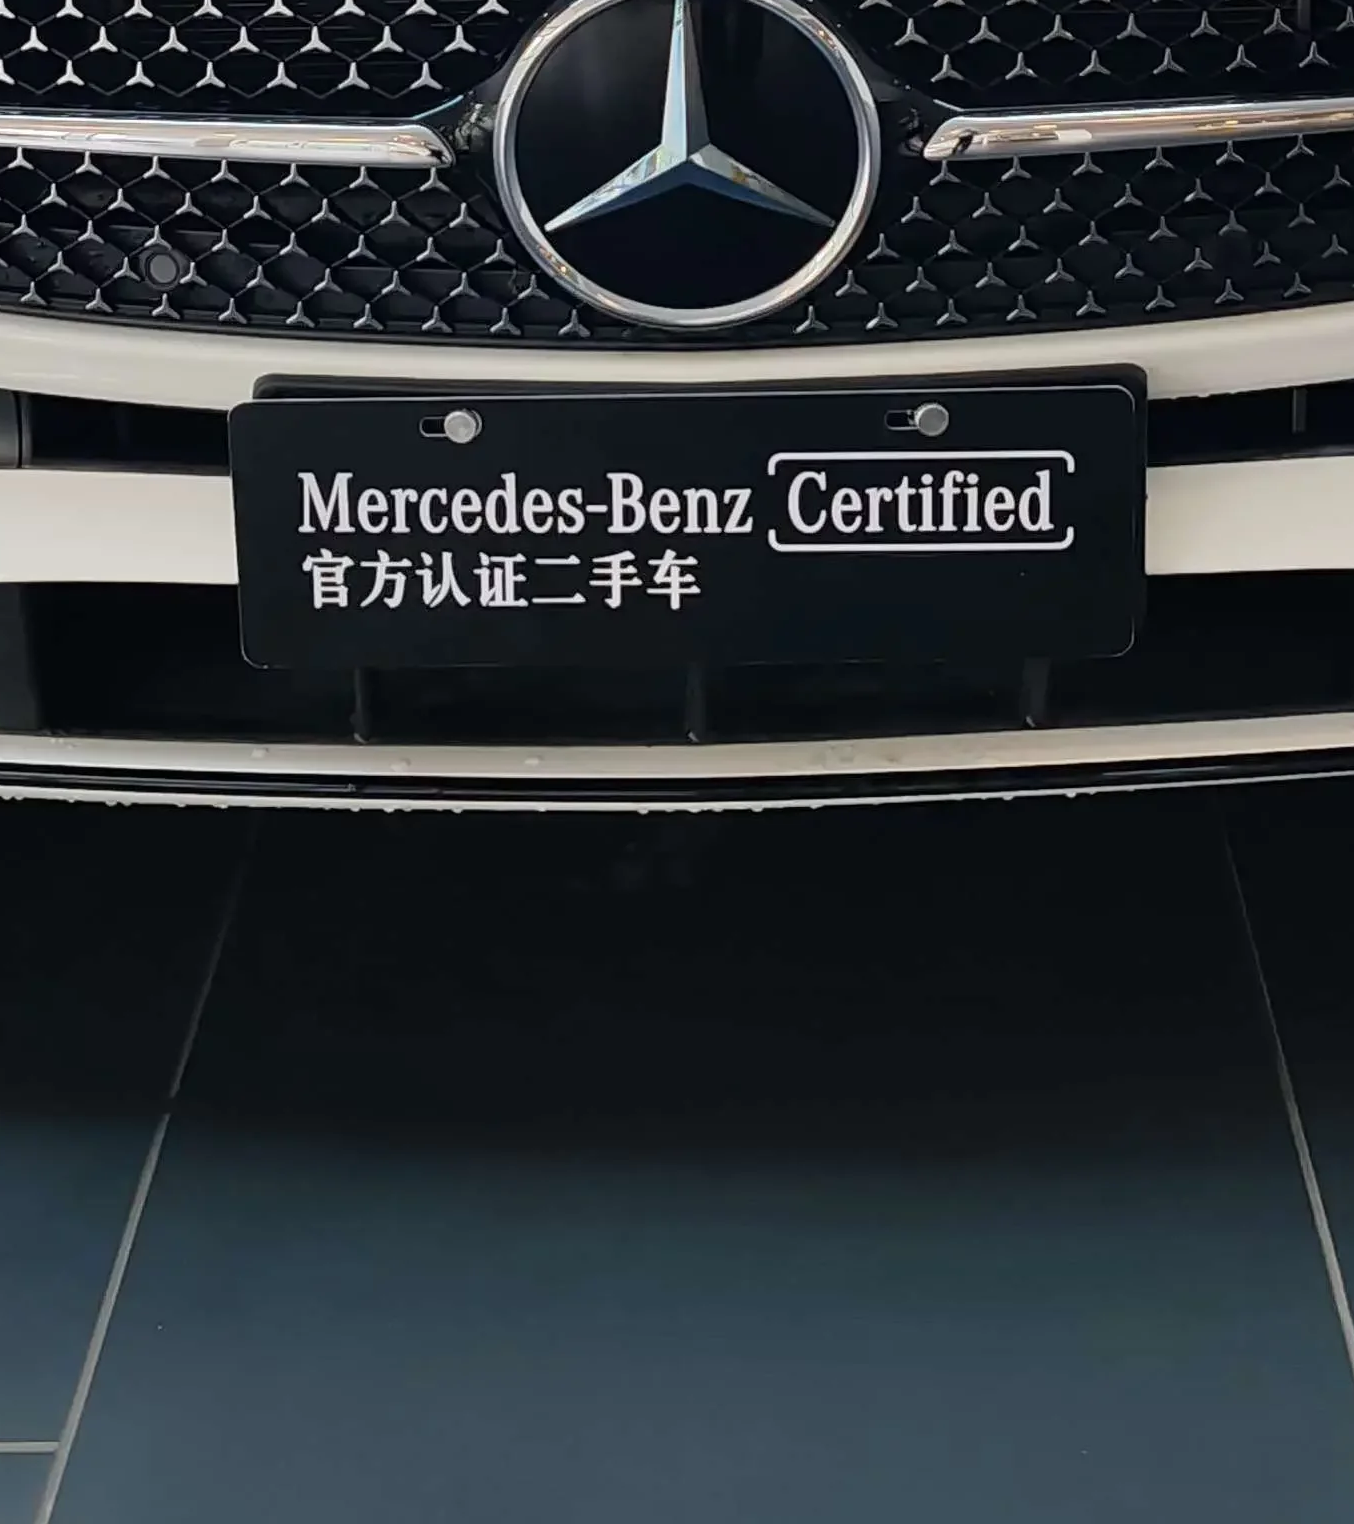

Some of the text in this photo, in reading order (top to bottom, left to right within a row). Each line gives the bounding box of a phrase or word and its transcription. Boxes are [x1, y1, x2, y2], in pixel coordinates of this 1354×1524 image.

[297, 469, 1055, 535] Mercedes-Benz Certified
[302, 548, 701, 610] 官方认证二手车
